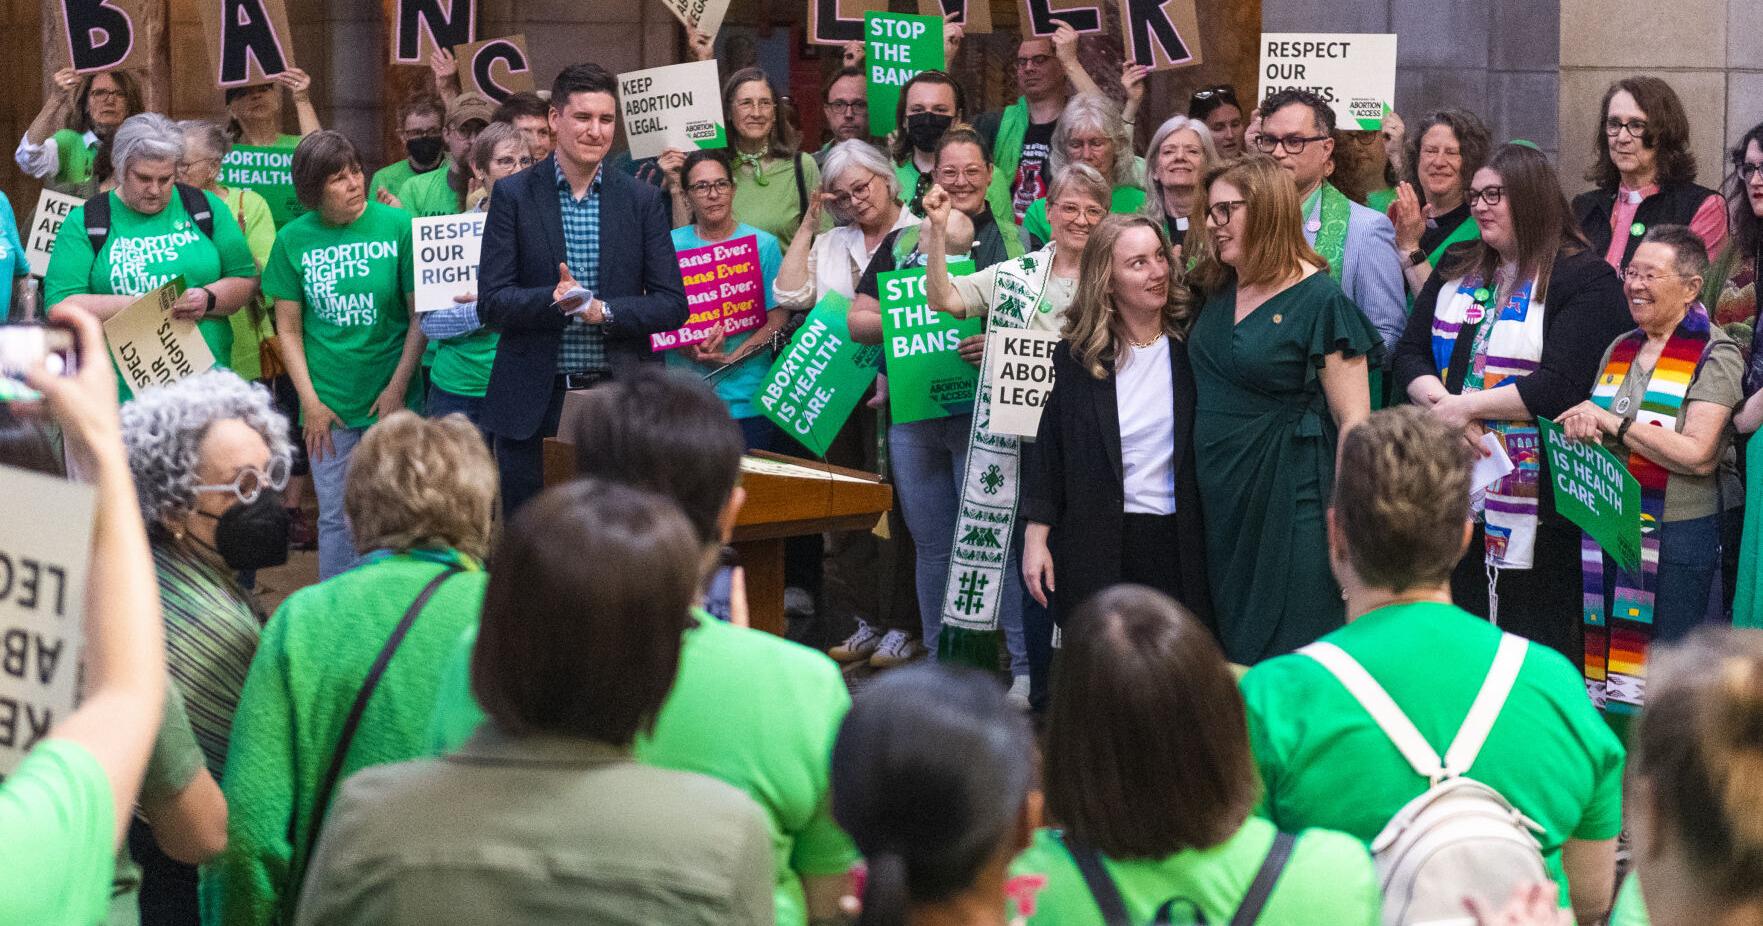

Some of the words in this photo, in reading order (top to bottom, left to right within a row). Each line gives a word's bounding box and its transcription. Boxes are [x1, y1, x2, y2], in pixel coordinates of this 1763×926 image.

[870, 18, 926, 39] STOP
[218, 0, 289, 86] A
[870, 42, 911, 63] THE
[1267, 41, 1351, 58] RESPECT
[1266, 63, 1306, 80] OUR
[622, 77, 653, 96] KEEP
[1265, 85, 1340, 103] RTS.
[626, 91, 693, 116] ABORTION
[1350, 101, 1381, 109] ABORTION
[1356, 109, 1381, 117] ACCESS
[628, 117, 668, 136] LEGAL.
[228, 168, 294, 185] HEALTH
[111, 230, 200, 252] ABORTION
[109, 246, 179, 265] RIGHTS
[301, 240, 398, 268] ABORTION
[421, 244, 464, 263] OUR
[713, 243, 753, 262] Ever.
[110, 260, 149, 282] ARE
[303, 258, 370, 284] RIGHTS
[716, 261, 755, 280] Ever.
[719, 280, 757, 299] Ever.
[722, 299, 758, 318] Ever.
[888, 303, 940, 329] THE
[651, 332, 677, 348] No
[723, 315, 760, 333] Ever.
[892, 328, 962, 358] BANS
[760, 318, 828, 412] ABORTION
[776, 401, 796, 424] IS
[789, 333, 843, 399] HEALTH
[794, 386, 836, 435] CARE.
[1549, 429, 1624, 493] ABORTION
[1552, 450, 1570, 472] IS
[1573, 459, 1623, 516] HEALTH
[1557, 474, 1600, 516] CARE.
